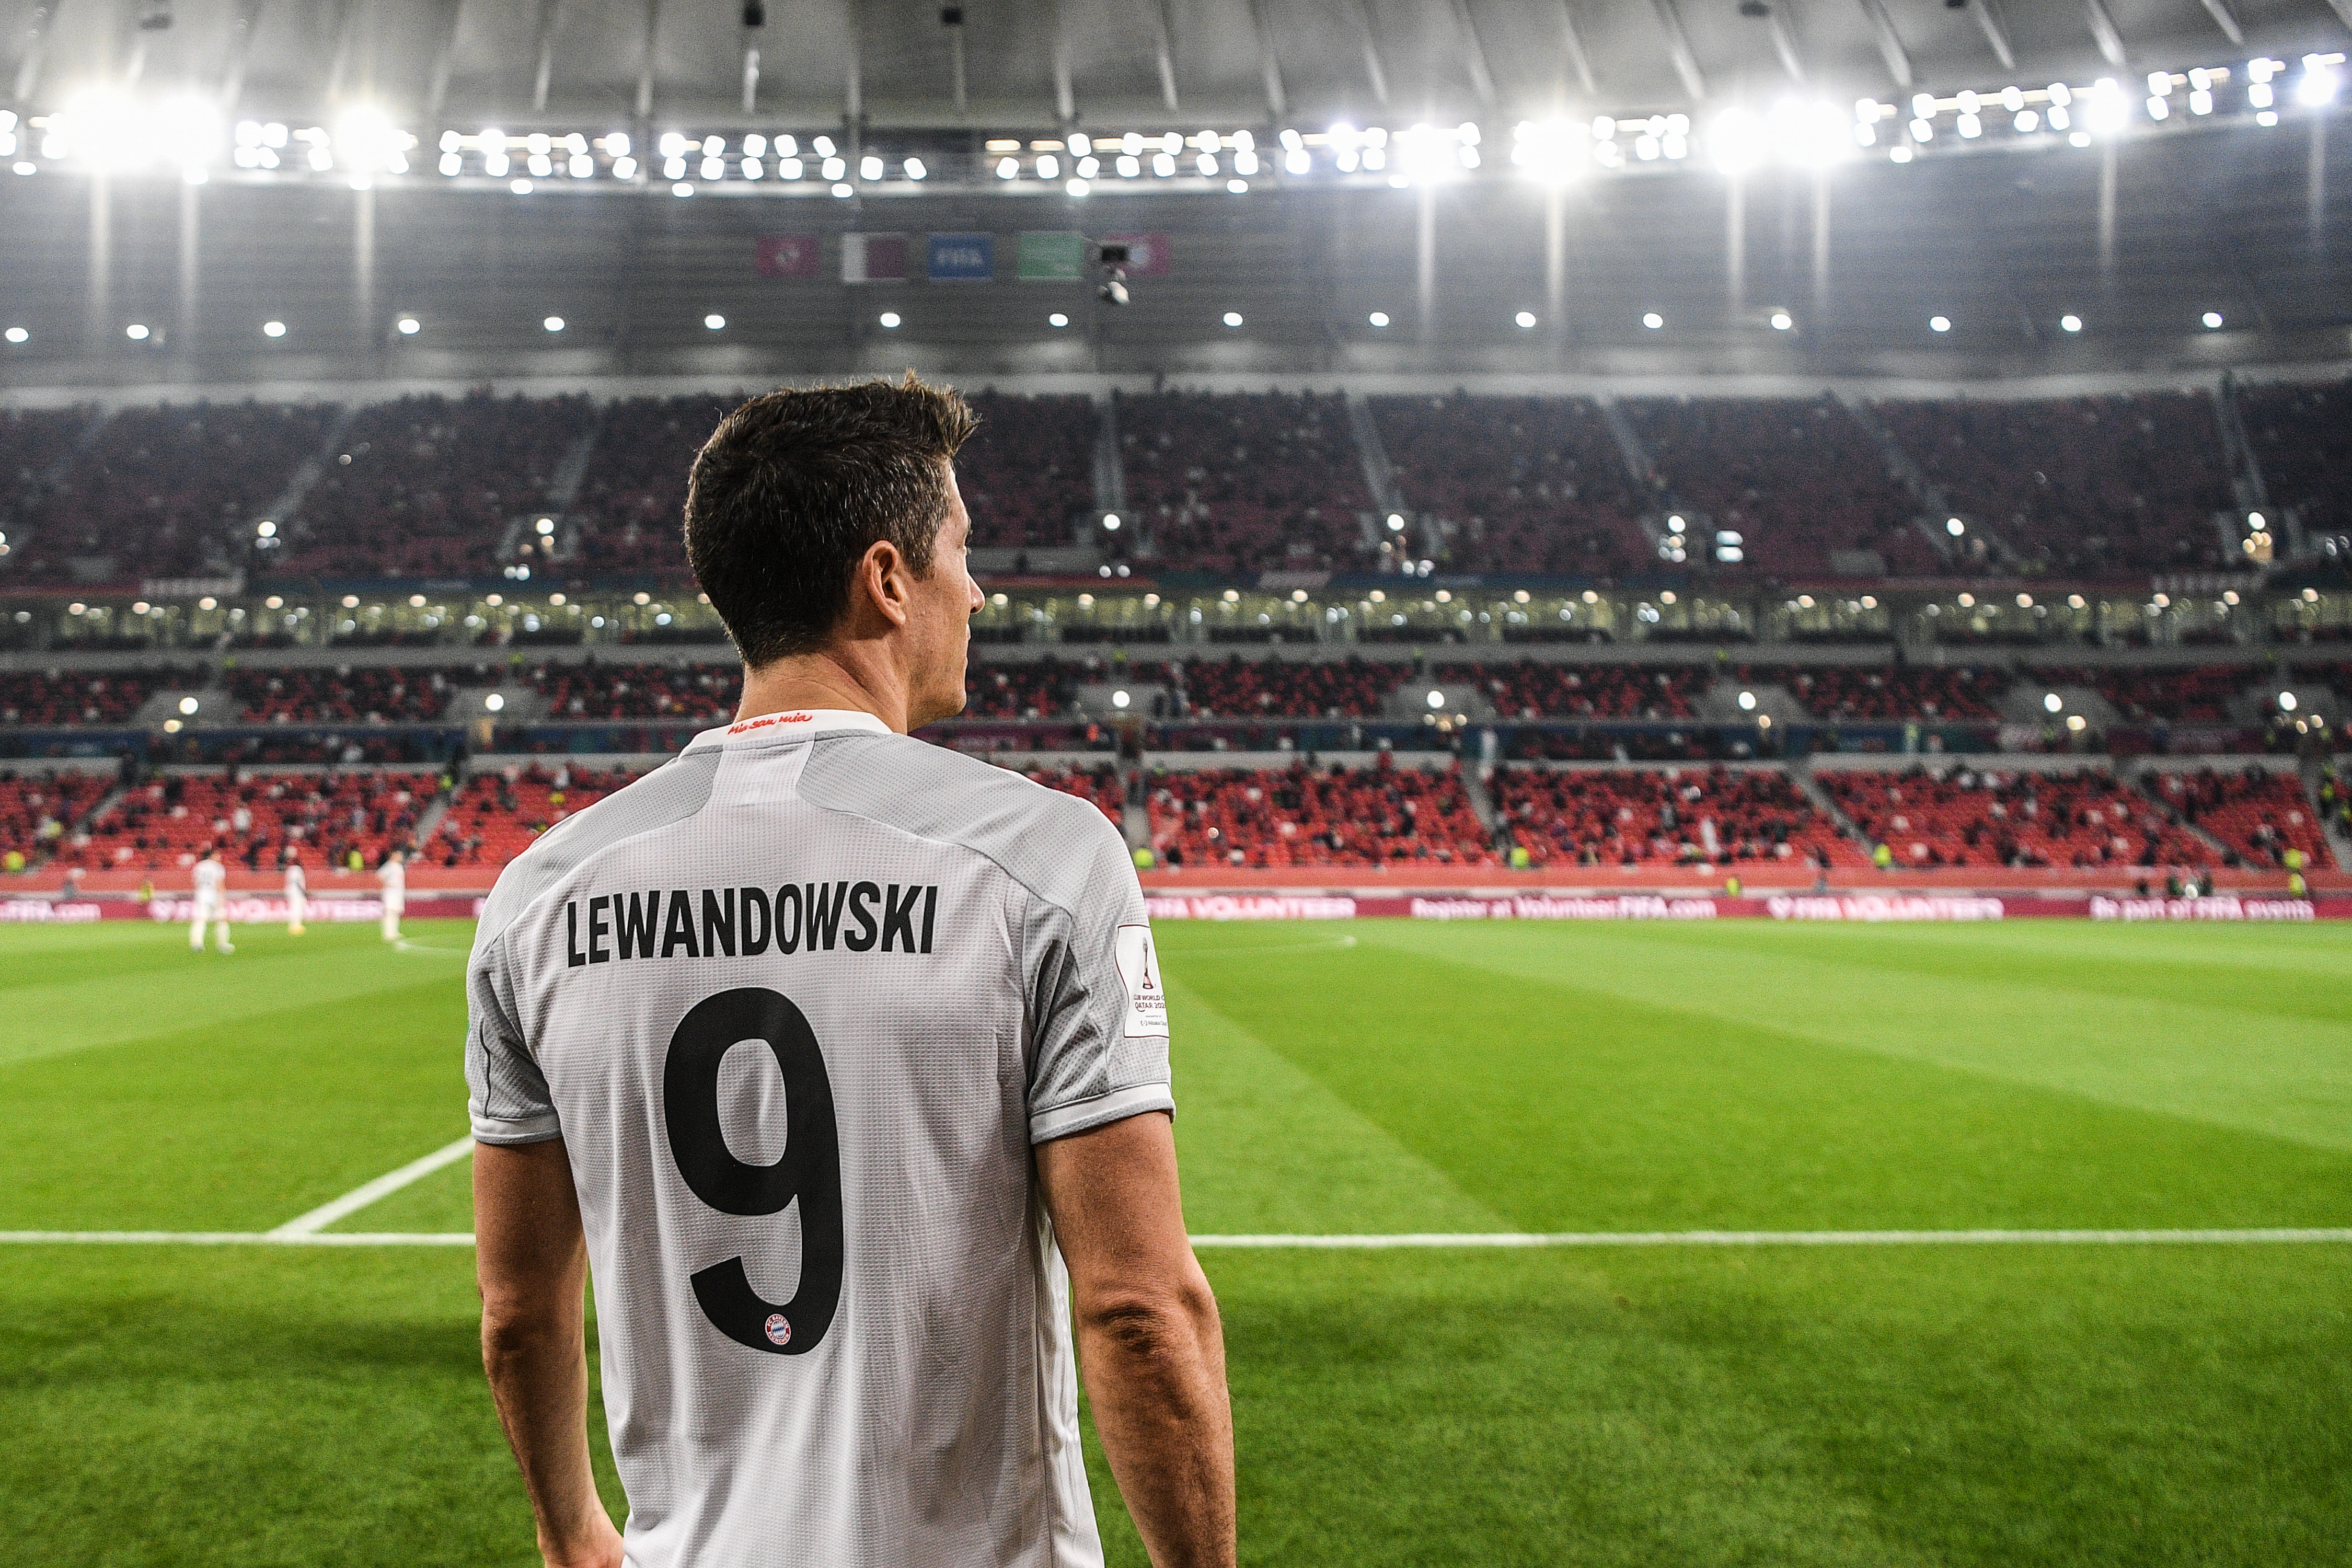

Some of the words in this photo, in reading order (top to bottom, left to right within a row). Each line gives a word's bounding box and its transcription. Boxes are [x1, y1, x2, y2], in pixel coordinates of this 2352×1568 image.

[728, 723, 747, 734] Mia
[748, 719, 777, 730] san
[778, 712, 813, 723] mia
[1188, 896, 1356, 919] VOLUNTEER
[567, 881, 938, 968] LEWANDOWSKI
[1135, 1002, 1154, 1012] QATAR
[663, 986, 844, 1355] 9
[772, 1316, 789, 1328] BAYERN
